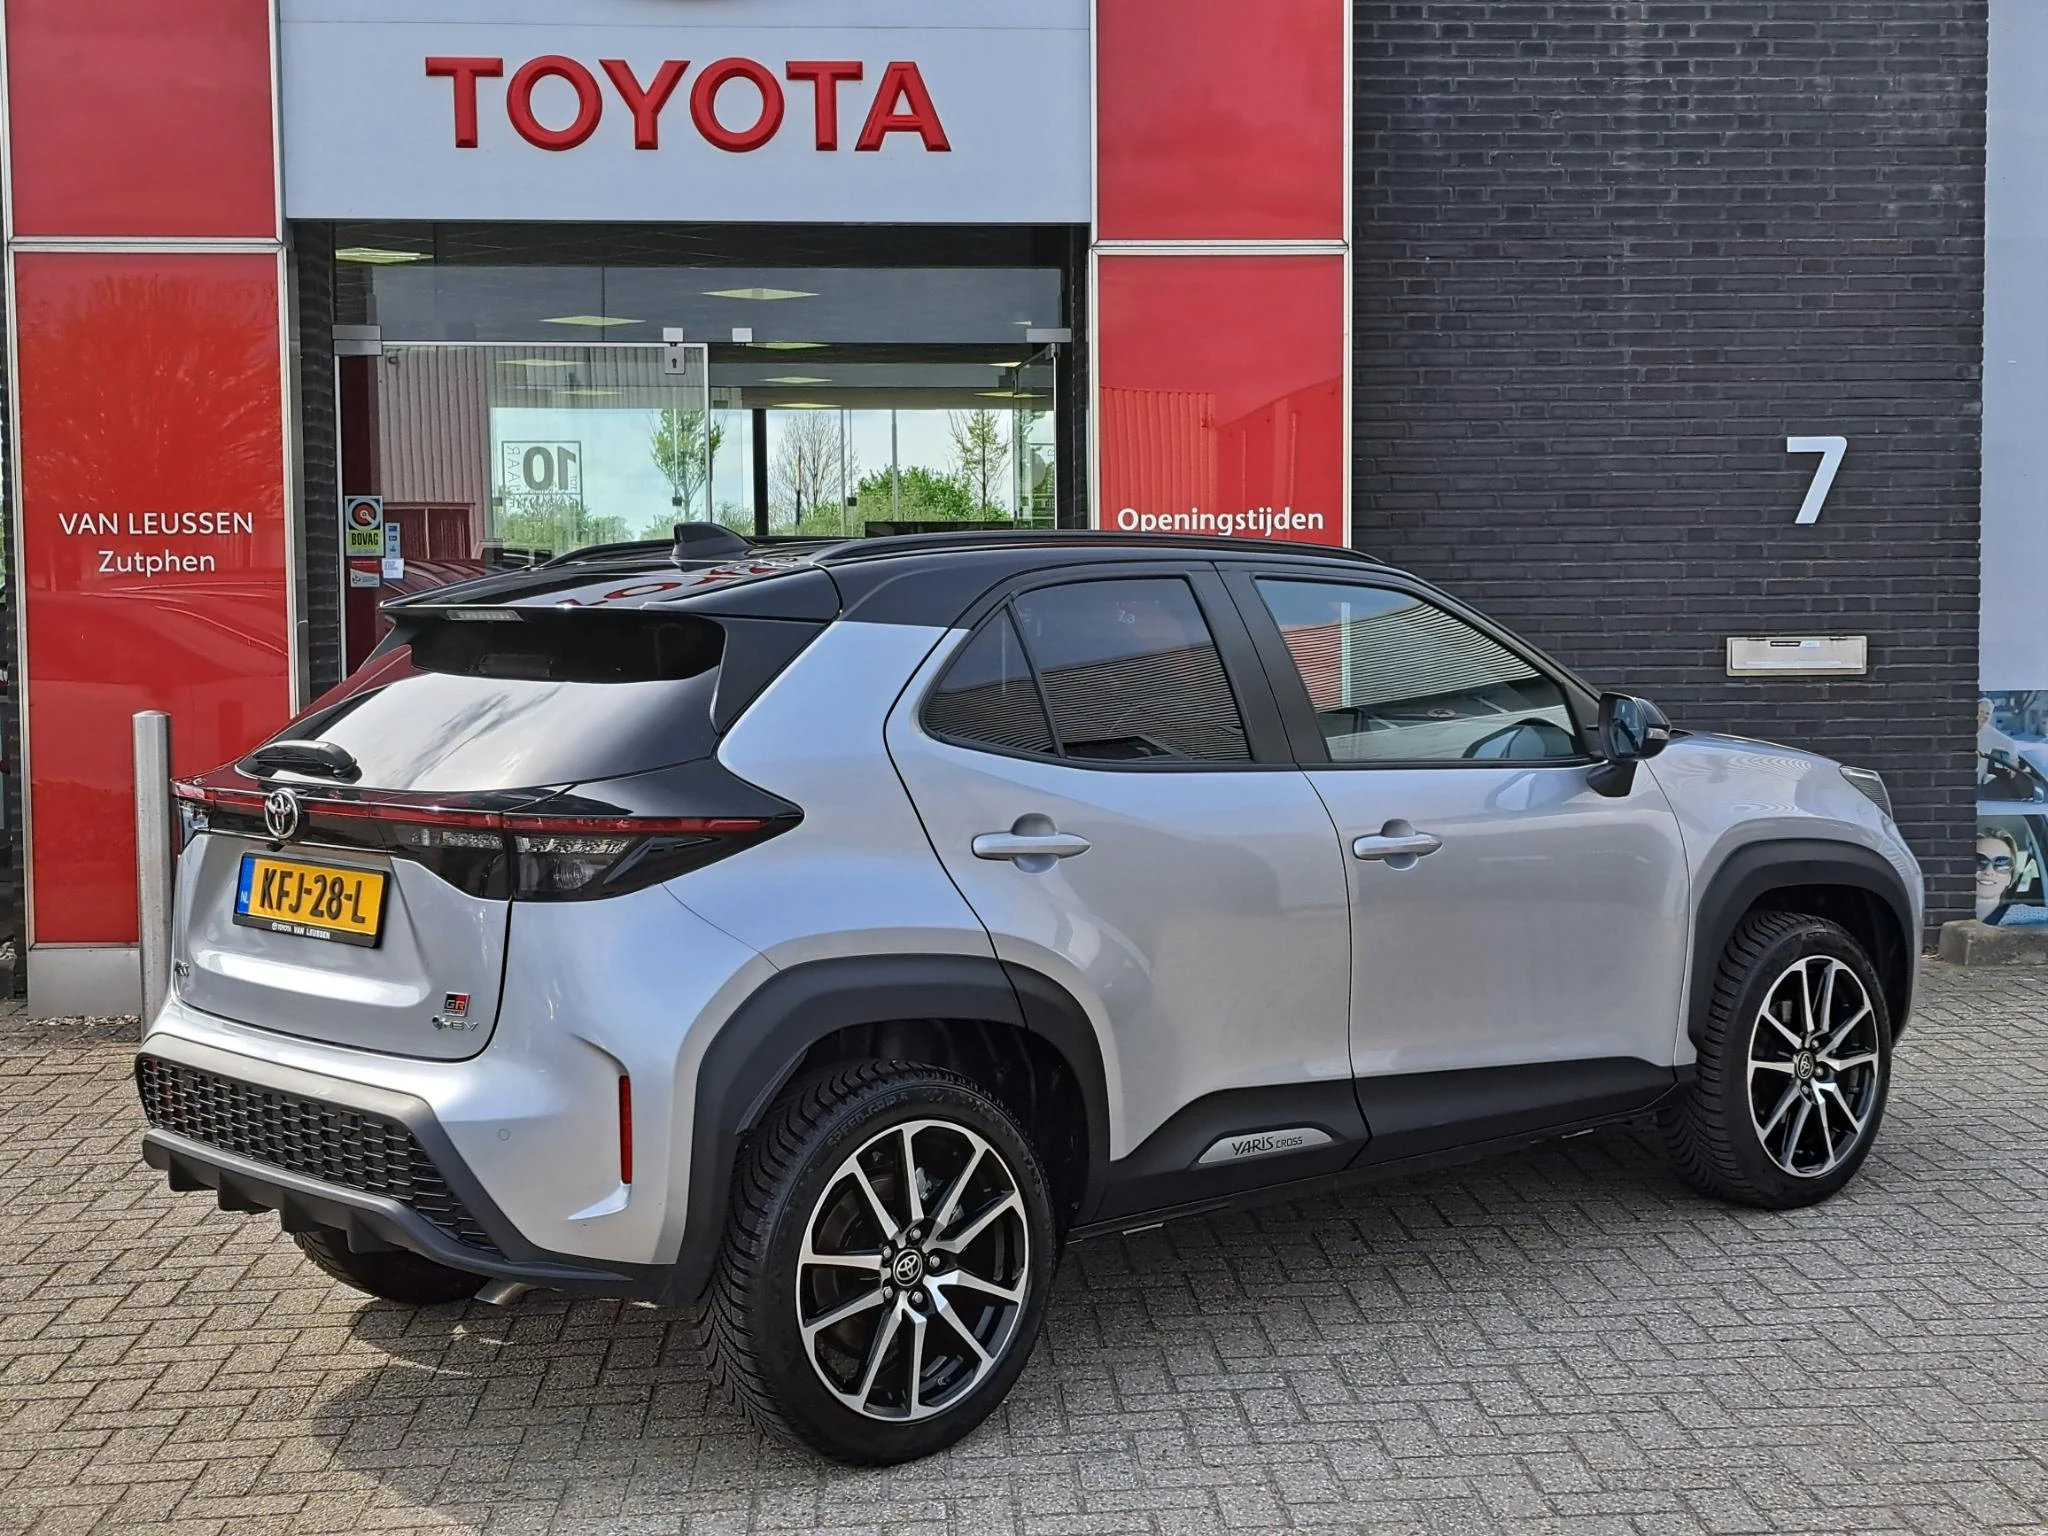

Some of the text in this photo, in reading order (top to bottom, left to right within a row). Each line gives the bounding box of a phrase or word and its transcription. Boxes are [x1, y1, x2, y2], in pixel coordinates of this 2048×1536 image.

[425, 55, 952, 153] TOYOTA
[1787, 436, 1848, 524] 7
[58, 512, 254, 535] VAN LEUSSEN
[1117, 507, 1325, 537] Openingstijden
[351, 533, 379, 546] BOVAG
[98, 549, 216, 578] Zutphen
[240, 891, 249, 904] NL
[259, 868, 366, 924] KFJ-28-L
[294, 926, 305, 935] VAN
[306, 928, 331, 939] LEUSSEN
[446, 999, 466, 1010] GR
[1232, 1136, 1303, 1155] YARIS CROSS
